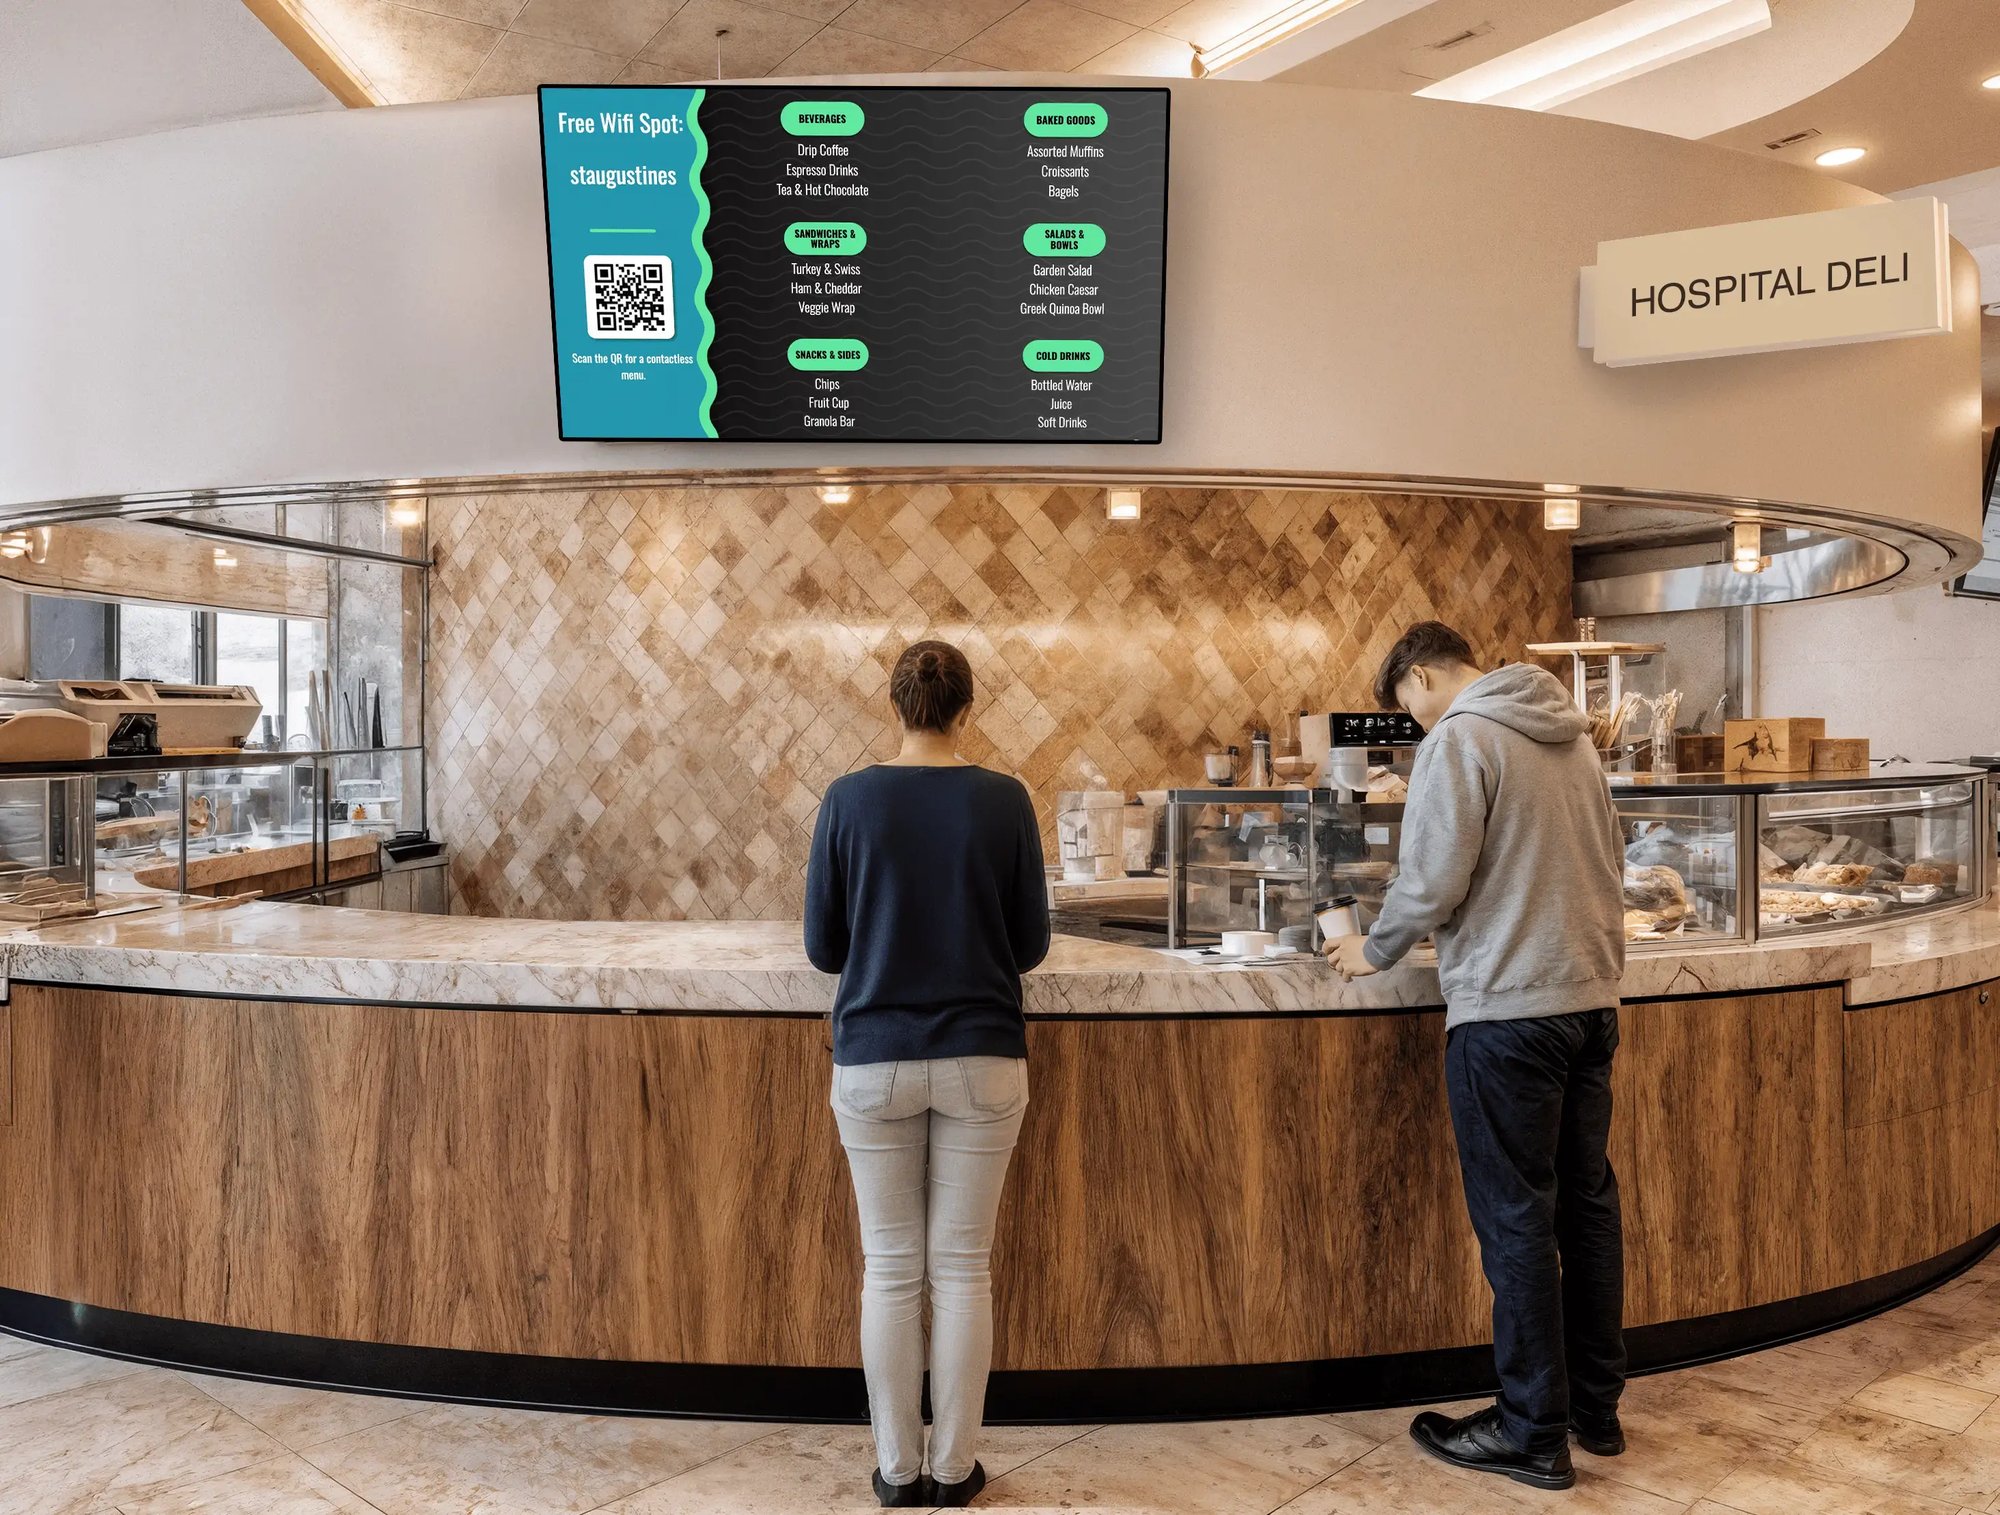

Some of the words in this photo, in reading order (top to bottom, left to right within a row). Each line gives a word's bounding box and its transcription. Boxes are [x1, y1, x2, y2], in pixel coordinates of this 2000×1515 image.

[799, 114, 846, 123] BEVERAGES
[1037, 116, 1064, 125] BAKED
[1067, 116, 1095, 125] GOODS
[559, 113, 594, 133] Free
[600, 113, 633, 133] Wifi
[640, 113, 683, 138] Spot:
[798, 144, 817, 158] Drip
[820, 144, 848, 156] Coffee
[1027, 145, 1067, 157] Assorted
[1070, 145, 1104, 157] Muffins
[787, 164, 826, 178] Espresso
[829, 164, 858, 176] Drinks
[1042, 165, 1089, 177] Croissants
[571, 166, 676, 189] staugustines
[776, 184, 792, 195] Tea
[795, 184, 802, 195] &
[806, 184, 821, 195] Hot
[824, 184, 868, 196] Chocolate
[1049, 185, 1079, 199] Bagels
[795, 229, 847, 238] SANDWICHES
[850, 230, 855, 238] &
[1045, 230, 1076, 238] SALADS
[1079, 230, 1084, 239] &
[811, 240, 840, 248] WRAPS
[1051, 241, 1078, 249] BOWLS
[792, 263, 821, 276] Turkey
[824, 263, 832, 275] &
[835, 263, 860, 275] Swiss
[1034, 264, 1065, 276] Garden
[1068, 264, 1092, 276] Salad
[791, 282, 811, 293] Ham
[815, 282, 822, 294] &
[825, 282, 862, 294] Cheddar
[1030, 284, 1065, 295] Chicken
[1068, 284, 1098, 295] Caesar
[1632, 266, 1815, 317] HOSPITAL
[1828, 252, 1907, 291] DELI
[799, 302, 829, 315] Veggie
[832, 302, 855, 315] Wrap
[1020, 303, 1047, 314] Greek
[1049, 303, 1080, 316] Quinoa
[1083, 303, 1104, 314] Bowl
[572, 353, 592, 363] Scan
[594, 354, 608, 363] the
[611, 354, 622, 365] QR
[625, 354, 637, 363] for
[647, 354, 693, 364] contactless
[796, 351, 827, 359] SNACKS
[830, 351, 835, 359] &
[838, 351, 860, 359] SIDES
[1037, 352, 1057, 360] COLD
[1060, 352, 1090, 360] DRINKS
[621, 372, 646, 380] menu.
[815, 378, 840, 392] Chips
[1031, 379, 1063, 391] Bottled
[1066, 380, 1092, 391] Water
[809, 397, 829, 408] Fruit
[832, 397, 849, 410] Cup
[1051, 398, 1072, 409] Juice
[804, 415, 837, 426] Granola
[840, 416, 855, 426] Bar
[1038, 416, 1056, 428] Soft
[1059, 417, 1087, 428] Drinks
